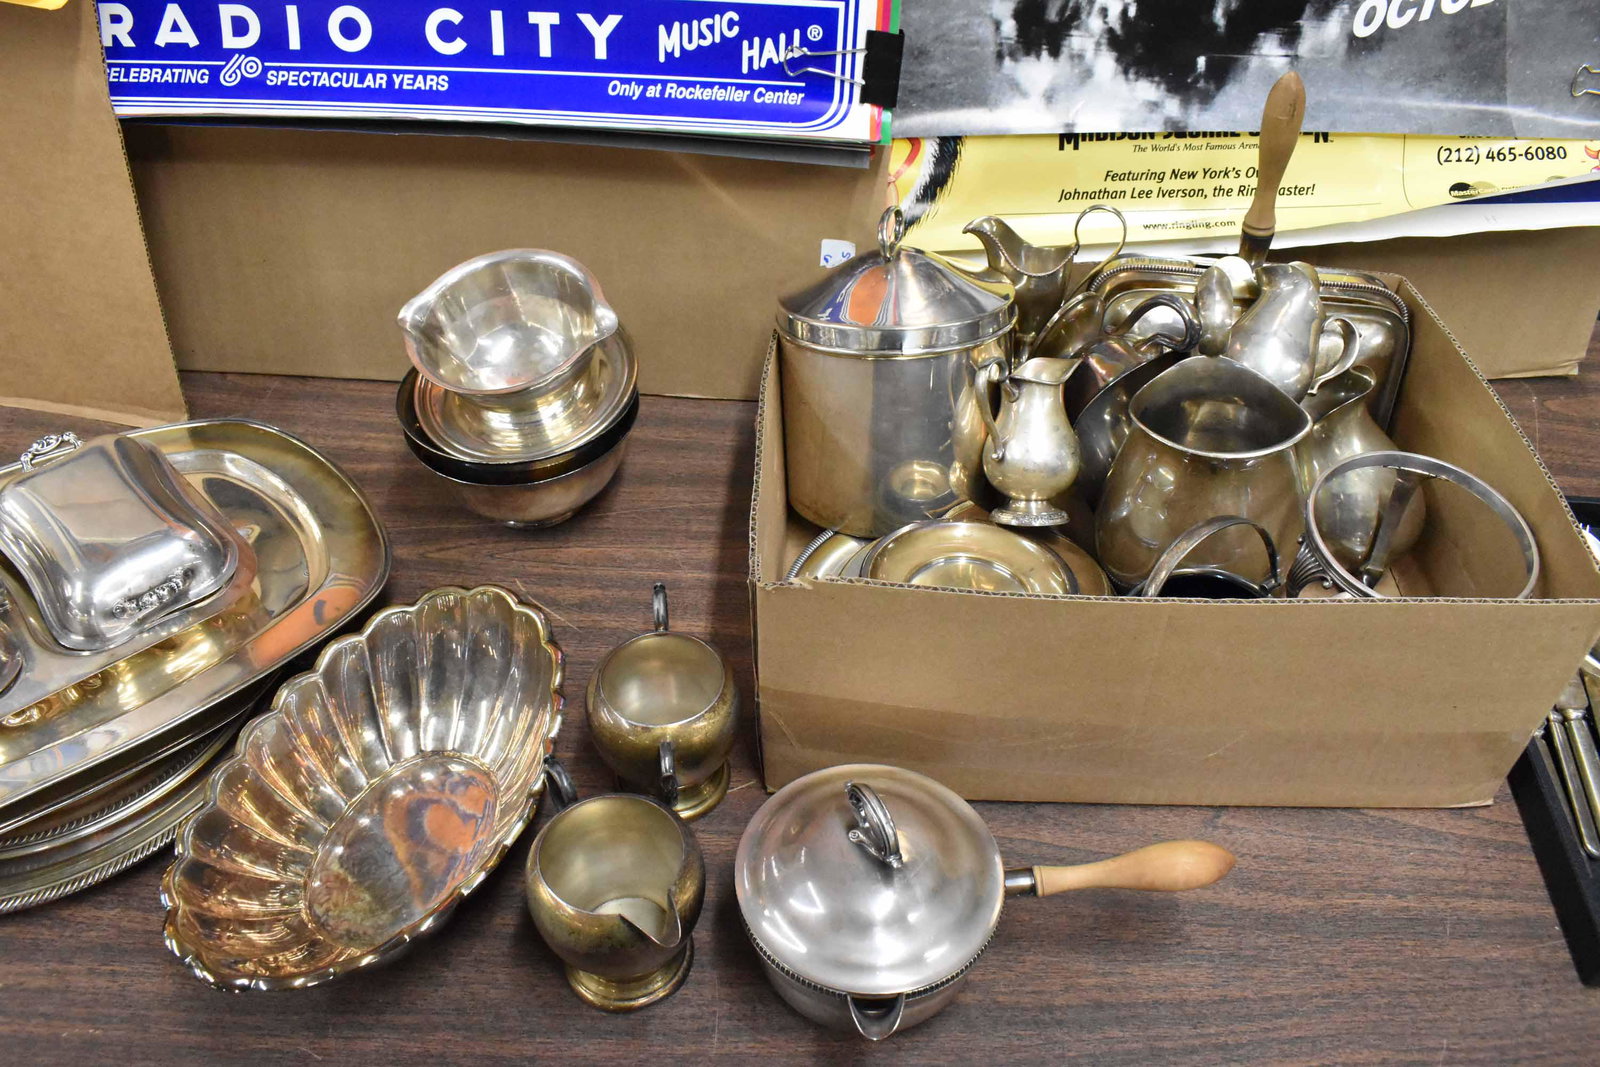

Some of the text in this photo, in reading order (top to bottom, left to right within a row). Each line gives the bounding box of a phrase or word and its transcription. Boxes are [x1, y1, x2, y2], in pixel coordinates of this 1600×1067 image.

[98, 3, 373, 52] RADIO
[424, 8, 623, 59] CITY
[659, 11, 739, 62] MUSIC
[108, 67, 209, 84] ELEBRATING
[266, 71, 387, 89] SPECTACULAR
[391, 73, 449, 91] YEARS
[608, 80, 805, 105] Only at Rockefeller Center
[1132, 142, 1259, 153] The World's Most Famous Aren
[1437, 146, 1567, 165] (212) 465-6080
[1104, 169, 1166, 183] Featuring
[1169, 168, 1198, 180] New
[1202, 167, 1241, 180] York's
[1058, 187, 1127, 203] Johnathan
[1130, 187, 1153, 199] Lee
[1156, 186, 1208, 199] Iverson,
[1212, 185, 1233, 197] the
